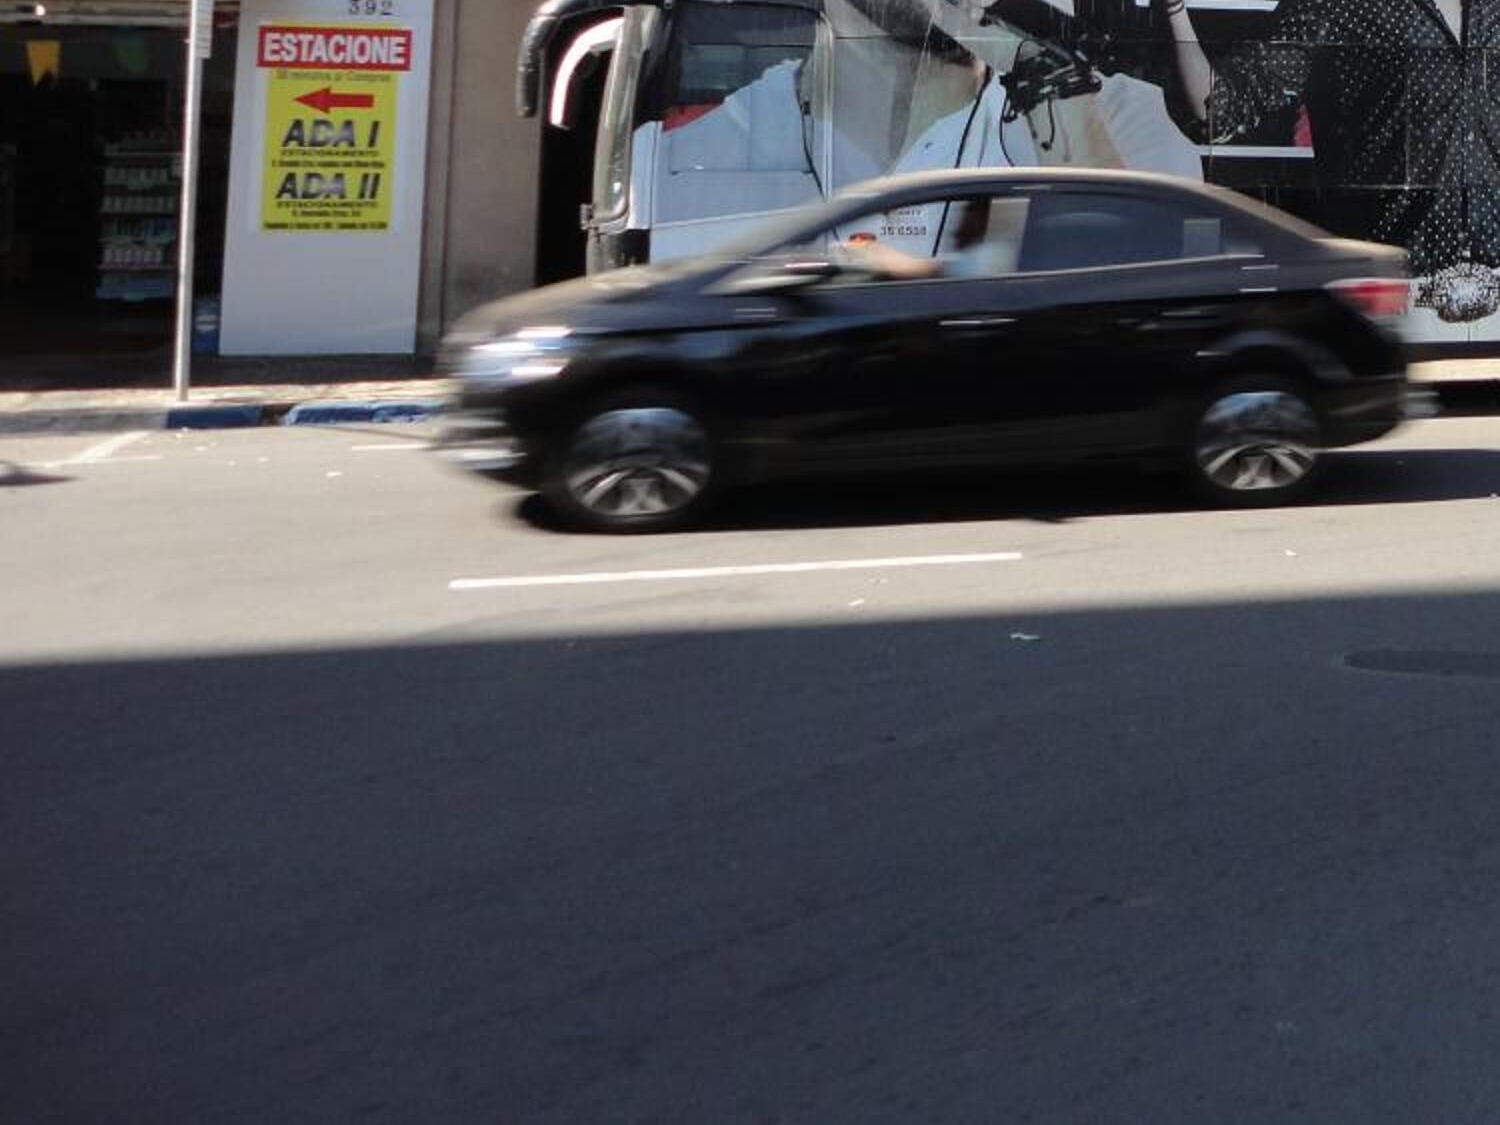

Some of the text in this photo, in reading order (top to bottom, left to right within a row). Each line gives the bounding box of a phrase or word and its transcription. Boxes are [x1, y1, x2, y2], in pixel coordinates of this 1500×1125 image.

[263, 32, 406, 64] ESTACIONE
[280, 118, 381, 148] ADA I
[274, 172, 381, 200] ADA II
